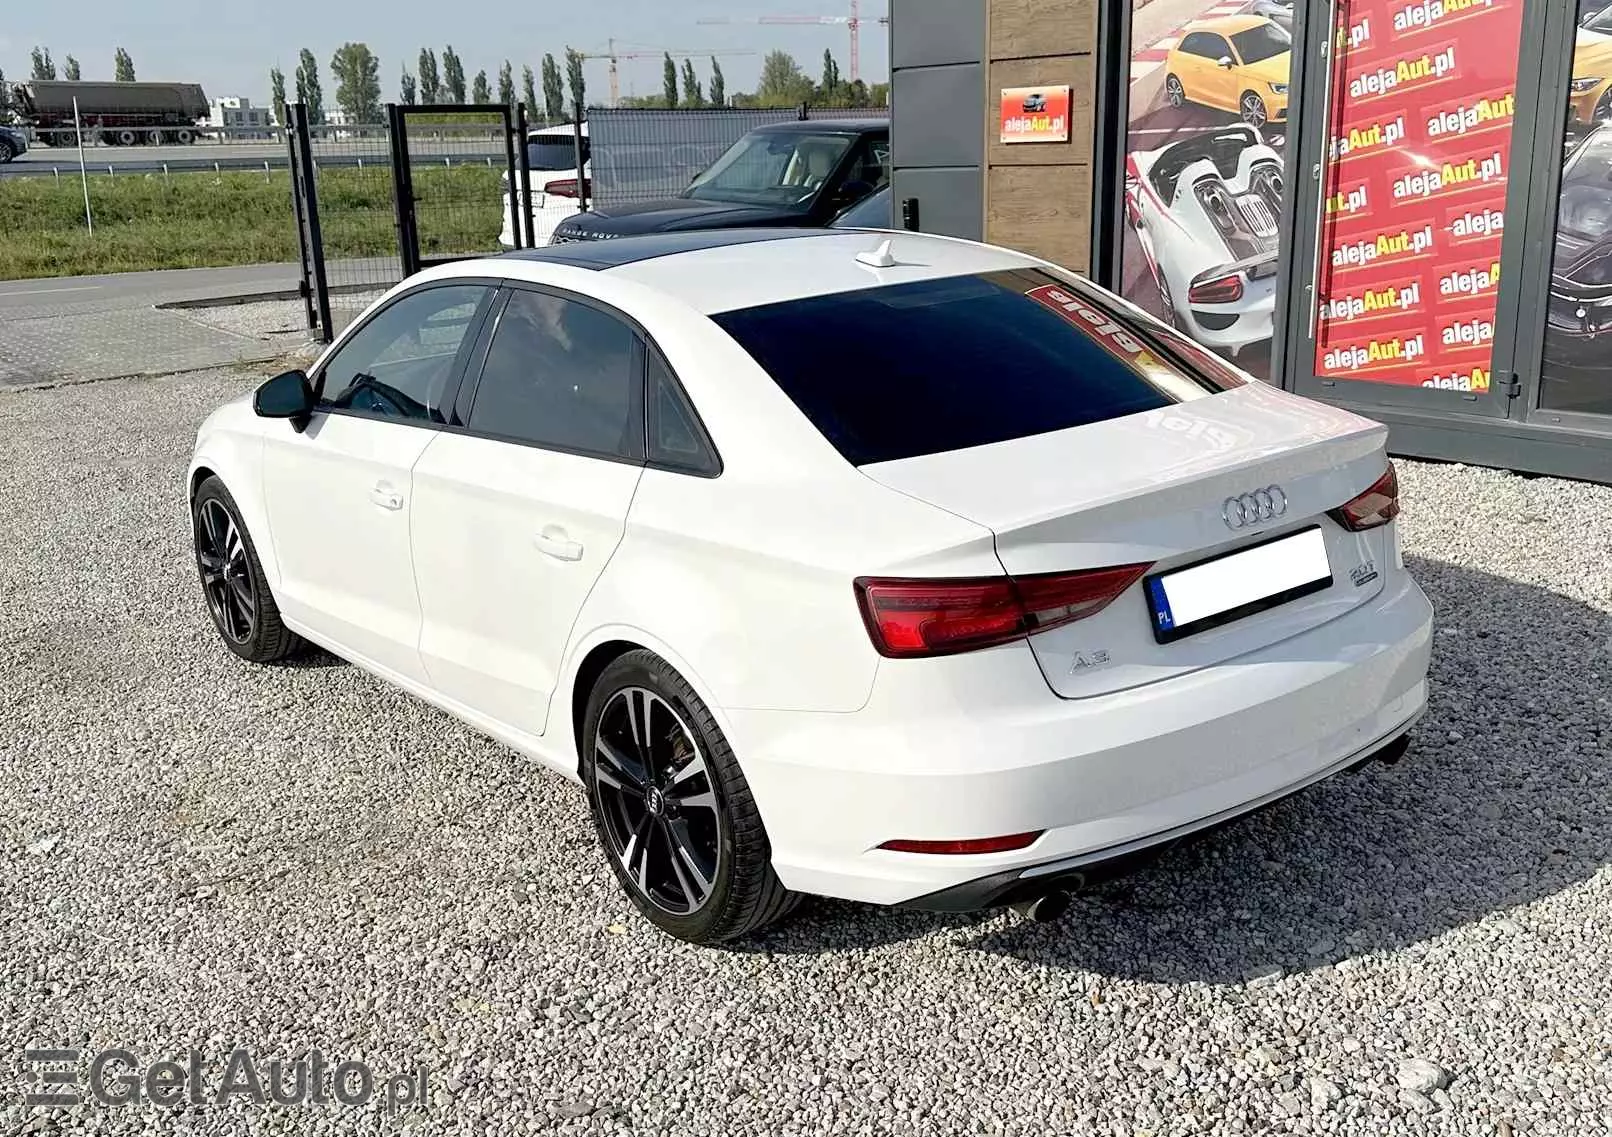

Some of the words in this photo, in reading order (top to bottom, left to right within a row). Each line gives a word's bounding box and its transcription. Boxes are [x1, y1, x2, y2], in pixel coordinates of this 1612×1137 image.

[1350, 47, 1455, 97] alejaAut.pl
[1004, 114, 1065, 134] alejaAut.pl
[1393, 152, 1502, 198] alejaAut.pl
[1331, 225, 1433, 267] alejaAut.pl
[1319, 282, 1420, 321] alejaAut.pl
[1323, 334, 1424, 370] alejaAut.pl
[1157, 611, 1171, 625] PL
[1069, 649, 1112, 675] A3
